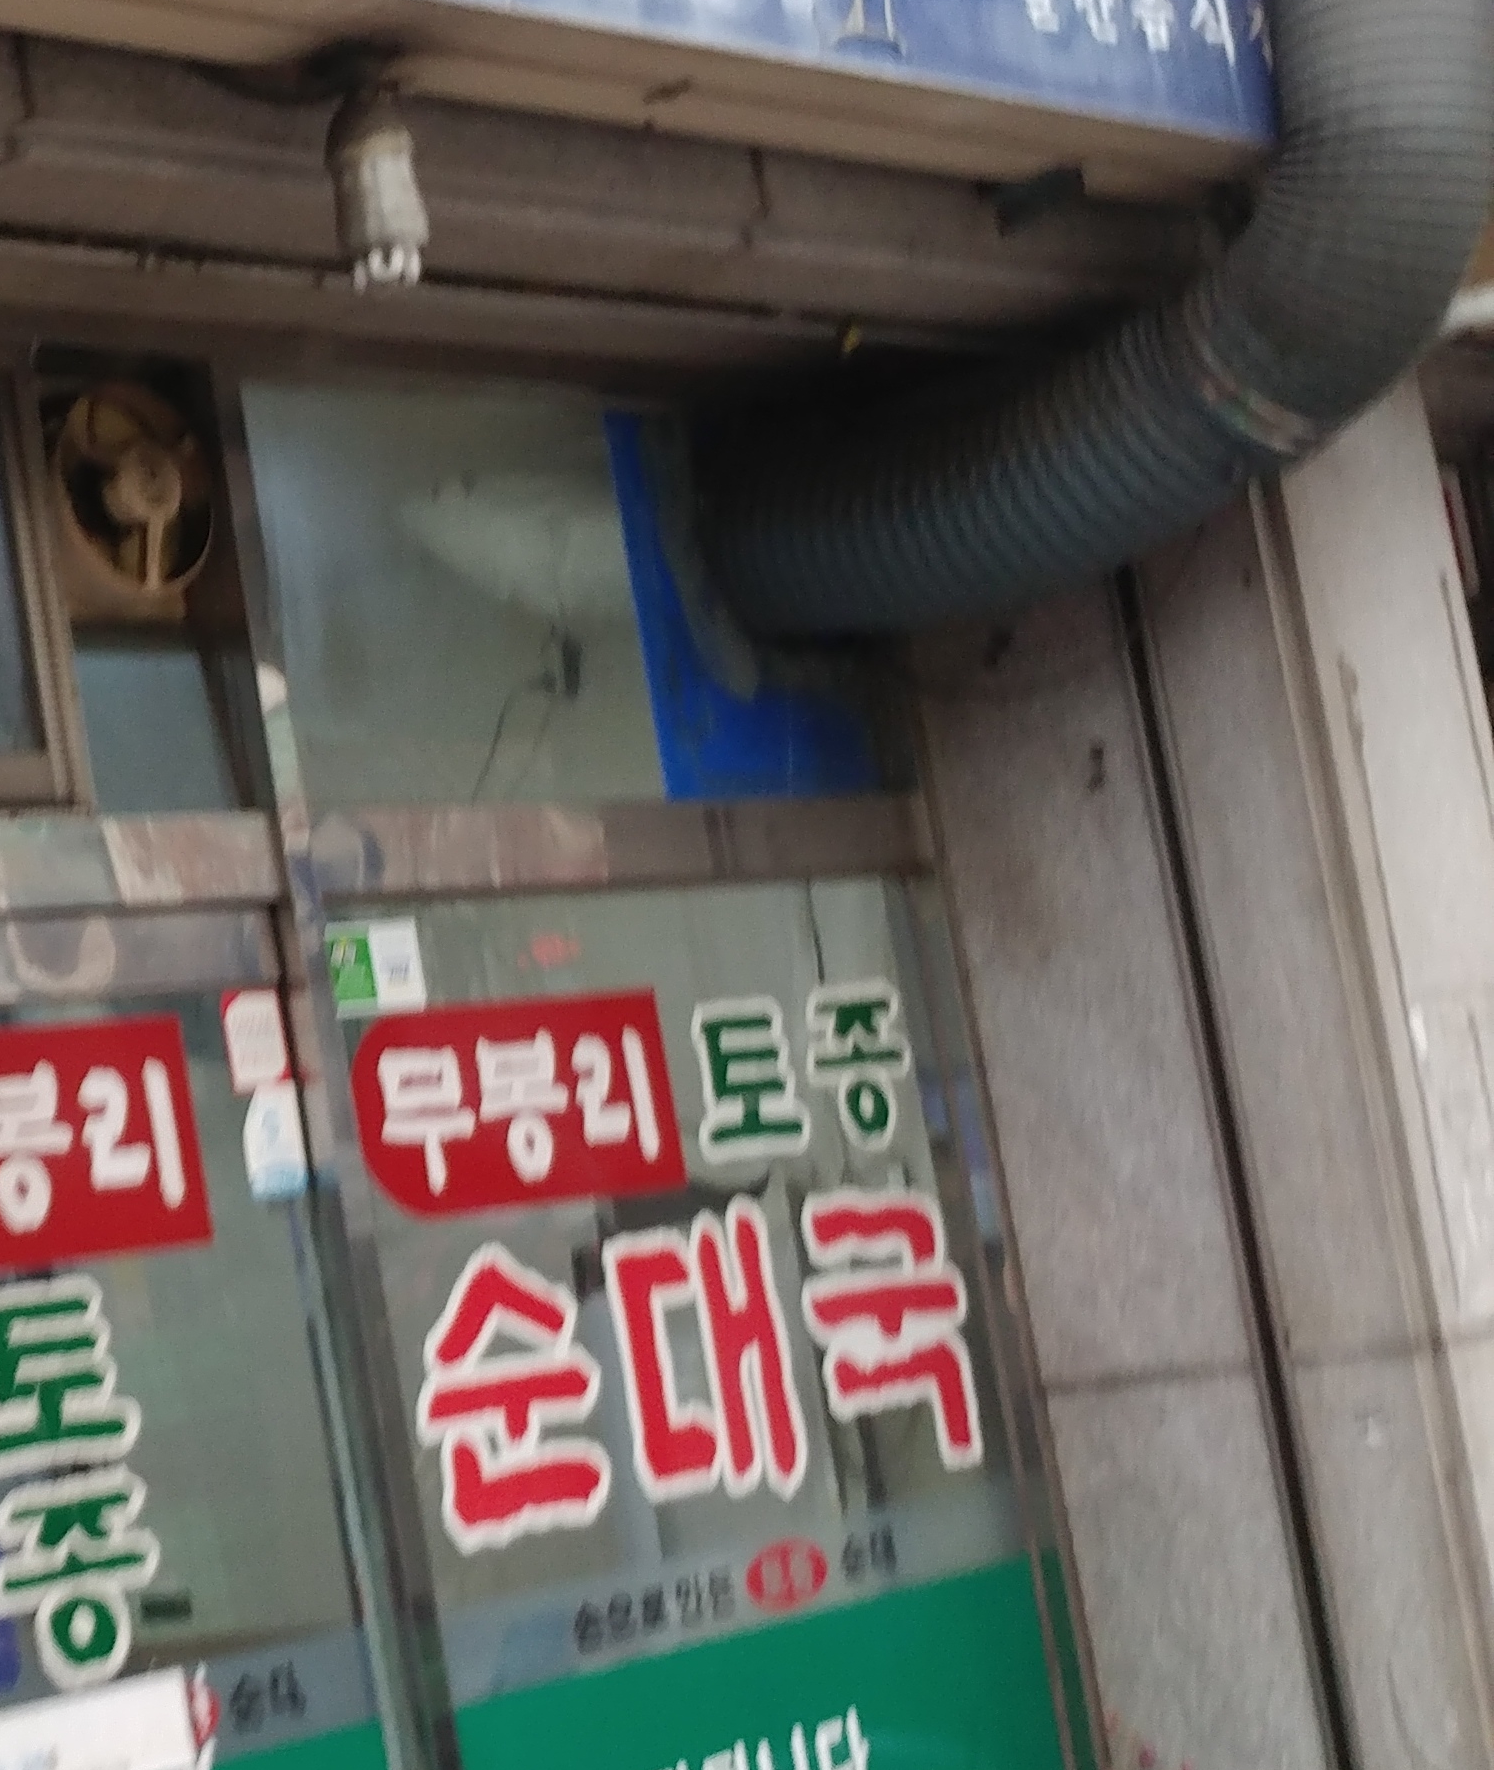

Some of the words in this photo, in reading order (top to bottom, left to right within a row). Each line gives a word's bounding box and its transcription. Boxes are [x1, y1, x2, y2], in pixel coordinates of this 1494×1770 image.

[375, 1026, 661, 1197] 무봉리
[690, 977, 910, 1159] 토종
[417, 1188, 985, 1556] 순대국
